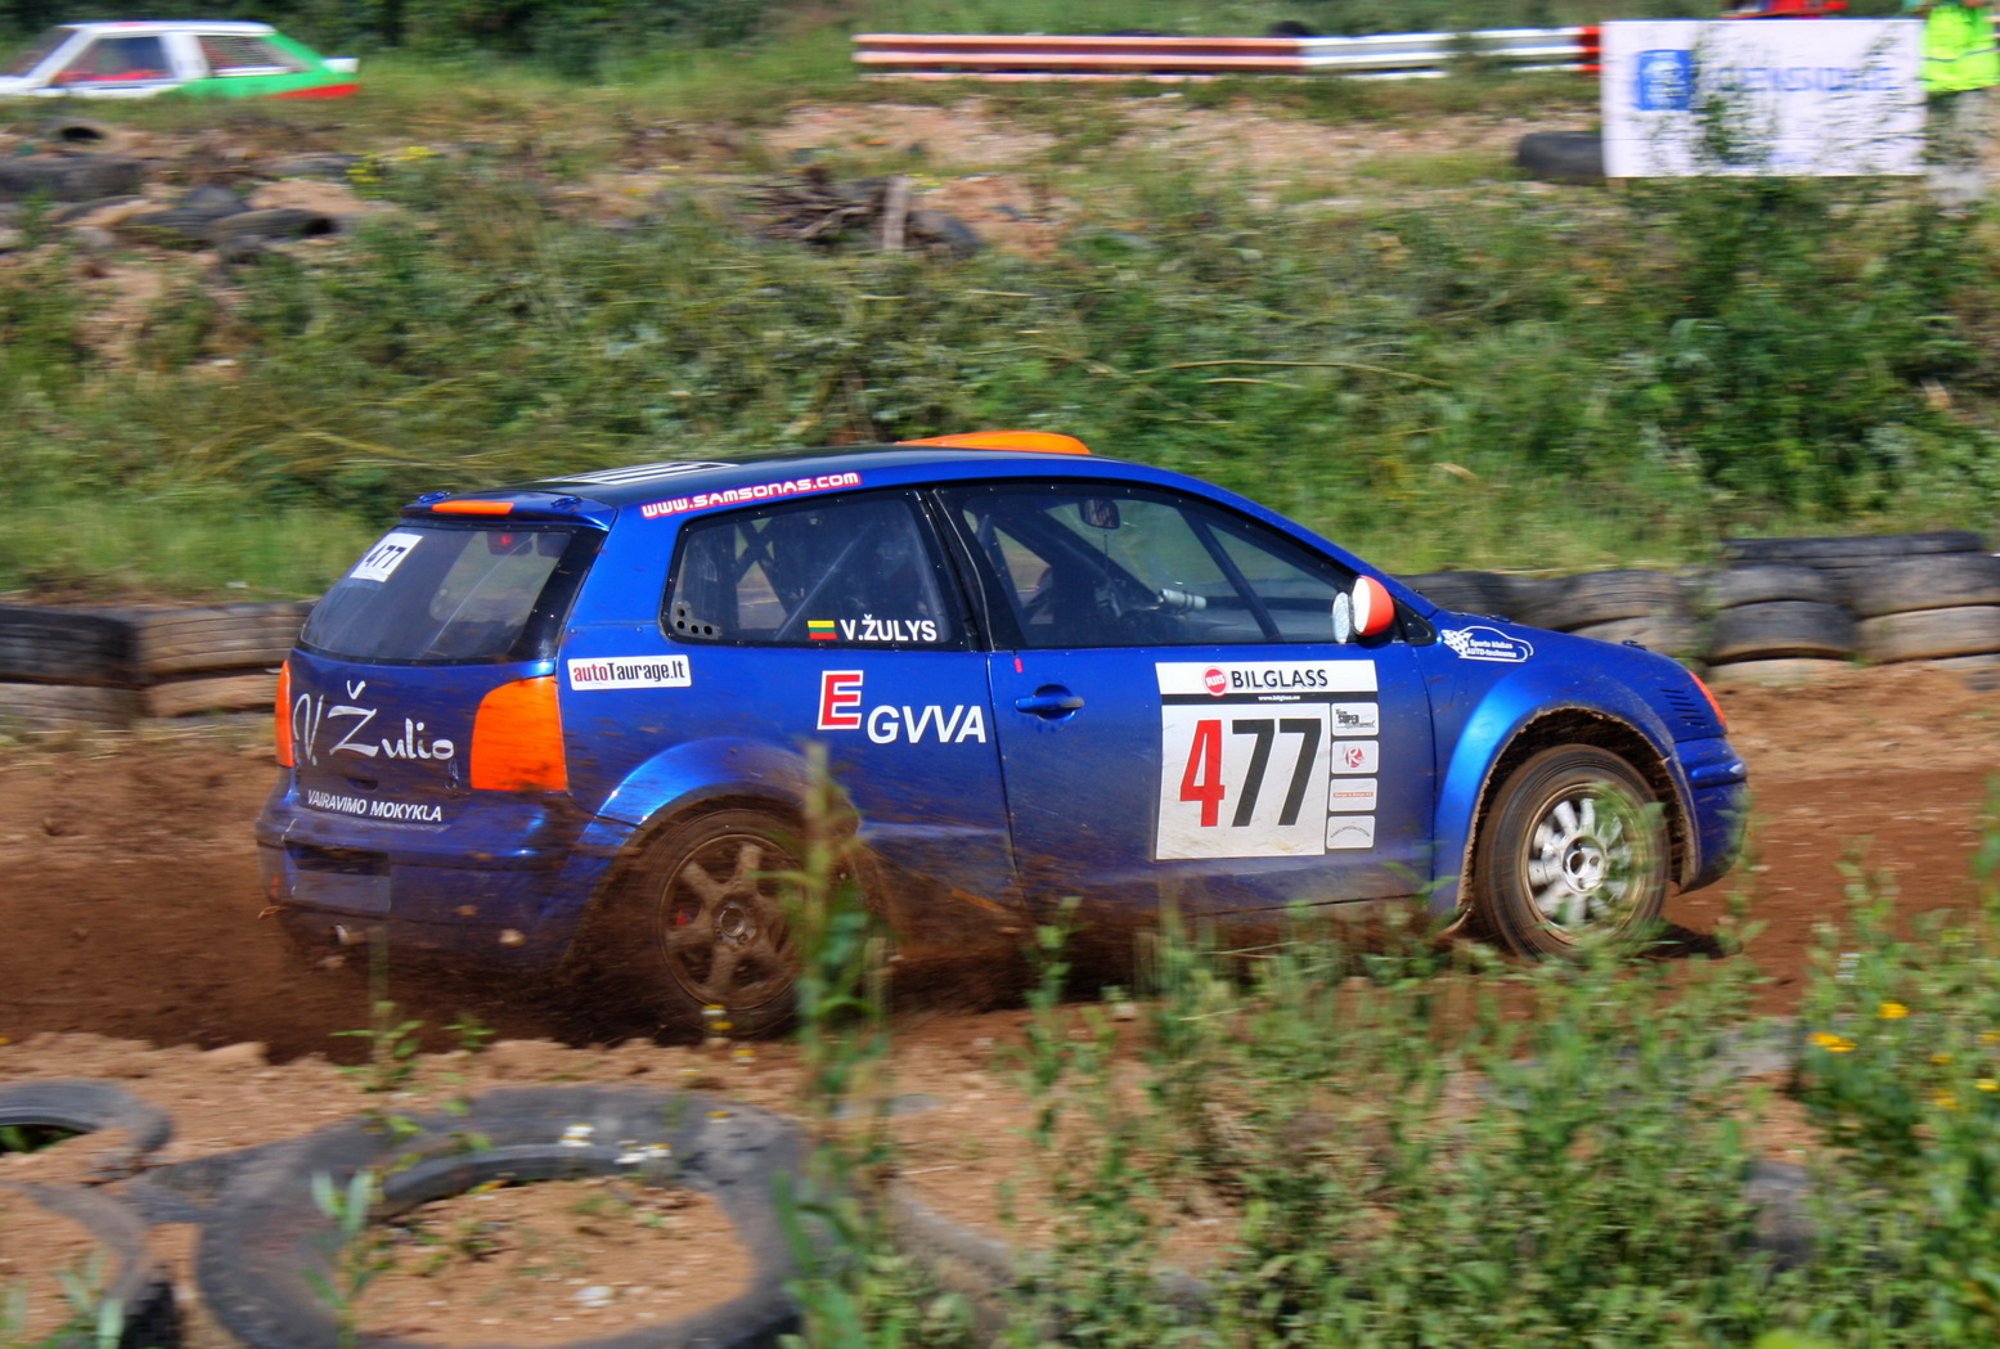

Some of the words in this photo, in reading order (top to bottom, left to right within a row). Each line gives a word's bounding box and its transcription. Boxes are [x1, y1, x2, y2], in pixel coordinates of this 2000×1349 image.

[365, 545, 407, 568] 477
[840, 614, 937, 641] V.ŽULYS
[573, 660, 686, 682] autoTaurage.lt
[1231, 669, 1328, 688] BILGLASS
[1179, 718, 1322, 828] 477
[308, 790, 367, 814] VAIRAVIMO
[370, 801, 442, 821] MOKYKLA
